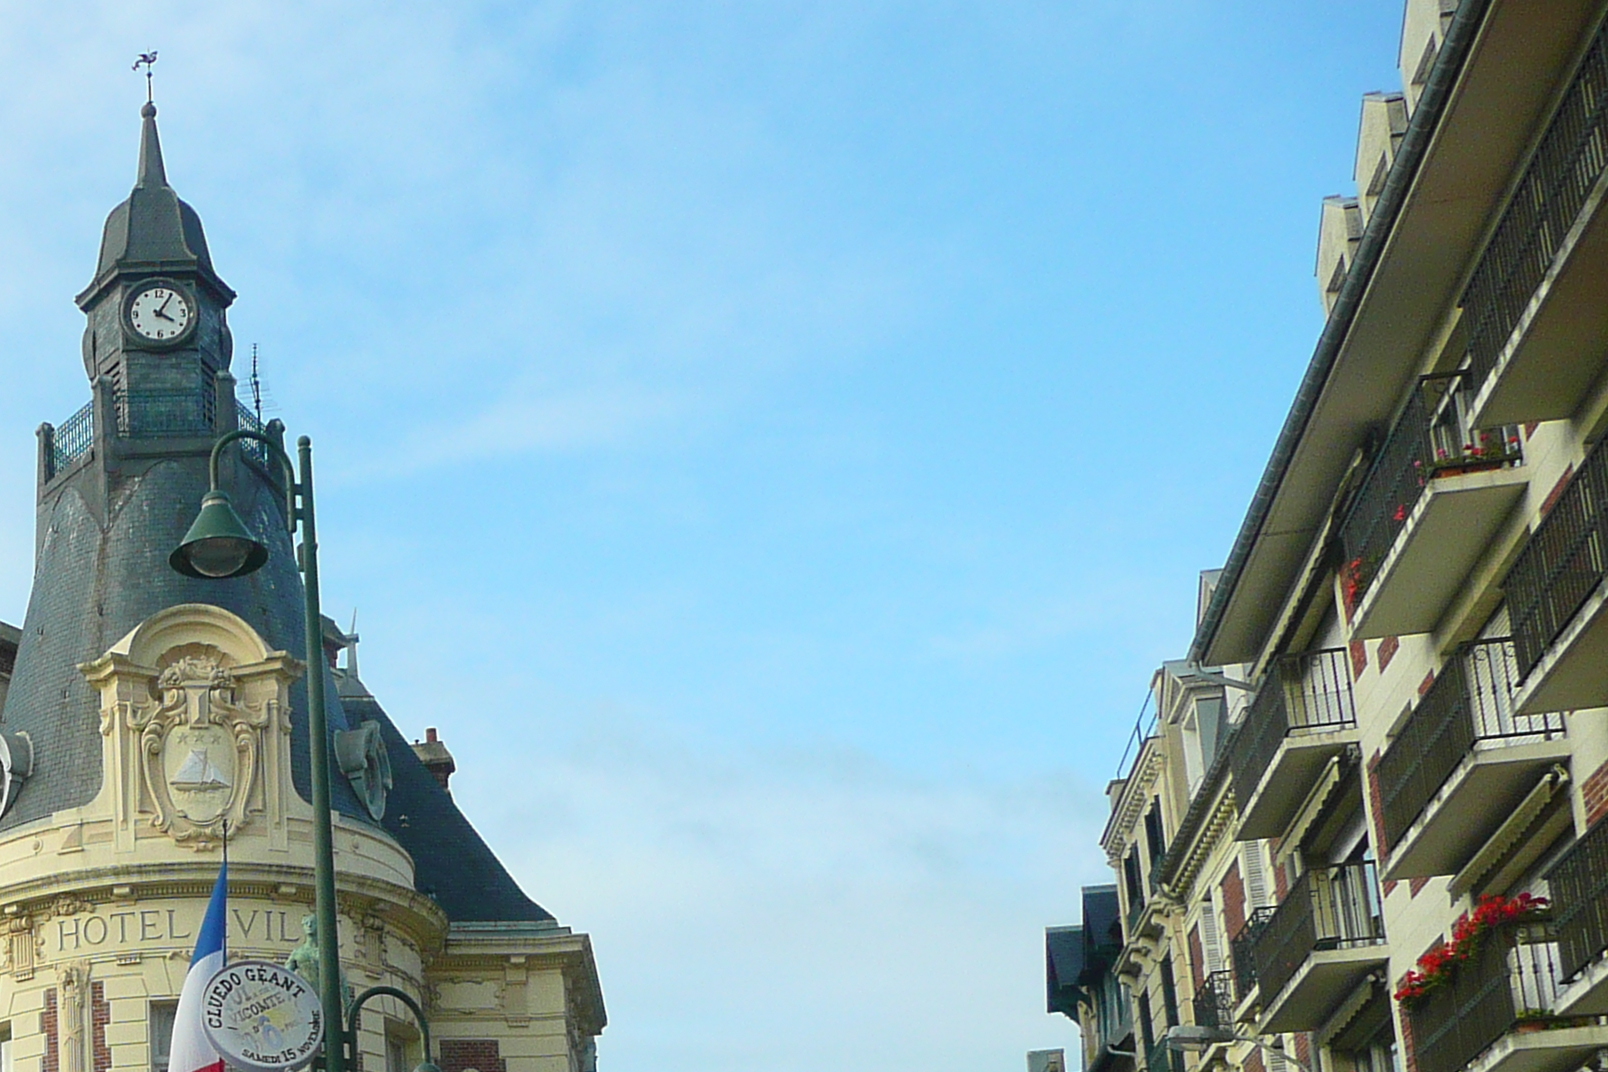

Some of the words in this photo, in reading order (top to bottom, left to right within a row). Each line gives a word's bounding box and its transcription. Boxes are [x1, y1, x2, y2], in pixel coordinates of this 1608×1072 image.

[155, 289, 164, 299] 12
[132, 310, 139, 319] 9
[180, 308, 187, 318] 3
[157, 329, 164, 339] 6
[58, 909, 191, 951] HOTEL
[207, 972, 241, 1029] CLUEDO
[245, 965, 306, 999] GÉANT
[241, 1048, 281, 1063] SAMEDI
[281, 1048, 297, 1062] 15
[297, 1010, 321, 1055] NOVEMBRE
